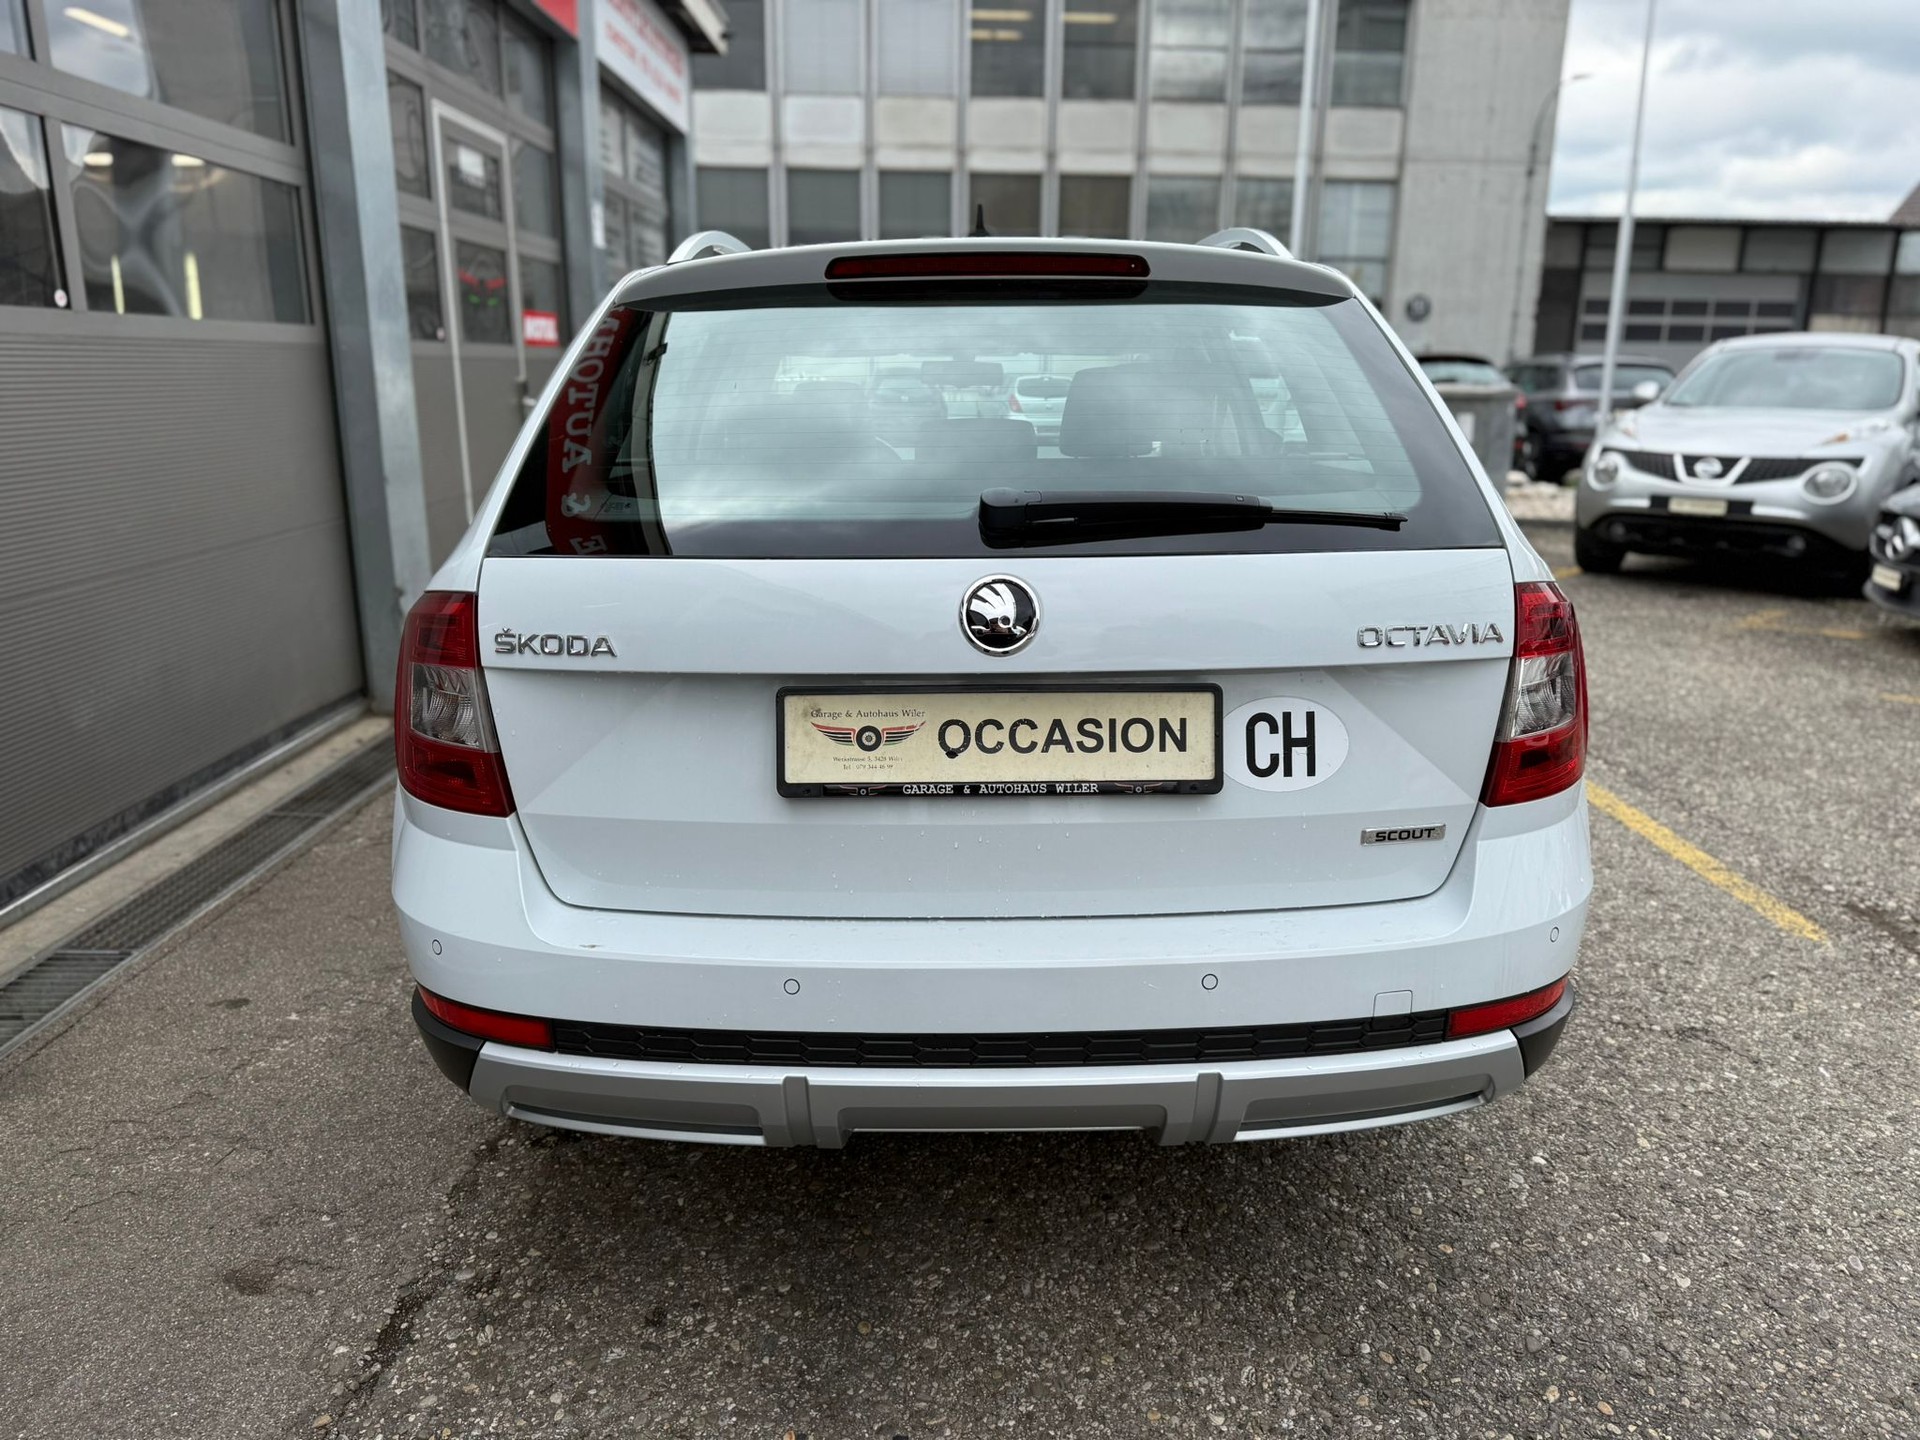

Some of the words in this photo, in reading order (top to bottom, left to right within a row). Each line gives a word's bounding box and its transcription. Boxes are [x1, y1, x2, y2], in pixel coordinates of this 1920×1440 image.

[494, 627, 618, 658] ŠKODA
[1356, 622, 1504, 648] OCTAVIA
[810, 709, 843, 720] Garage
[845, 709, 853, 718] &
[856, 709, 899, 718] Autohaus
[901, 708, 926, 718] Wiler
[937, 716, 1188, 756] OCCASION
[1245, 711, 1316, 778] CH
[902, 784, 954, 795] GARAGE
[963, 784, 971, 794] &
[979, 783, 1048, 794] AUTOHAUS
[1055, 783, 1099, 793] WILER
[1374, 827, 1436, 842] SCOUT
